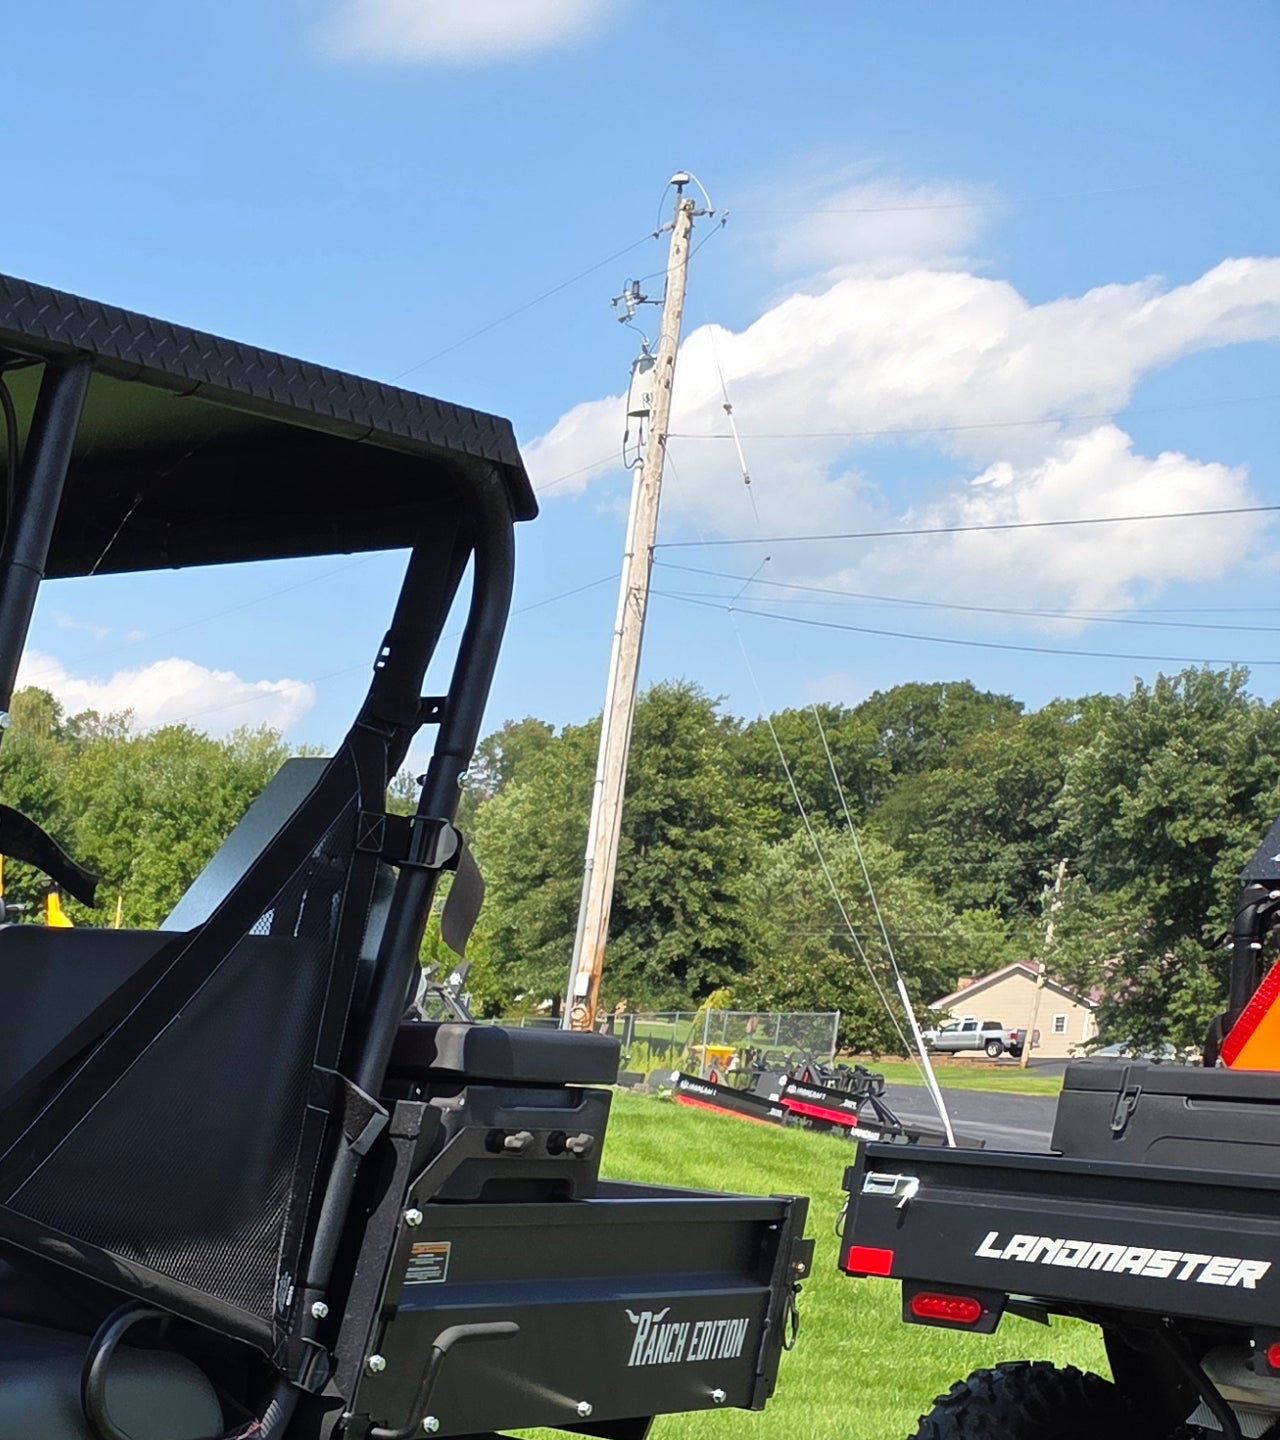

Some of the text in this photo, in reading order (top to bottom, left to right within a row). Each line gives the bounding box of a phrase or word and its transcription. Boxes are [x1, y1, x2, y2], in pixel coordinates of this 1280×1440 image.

[974, 1231, 1272, 1290] LANDMASTER
[625, 1308, 750, 1366] RANCH EDITION
